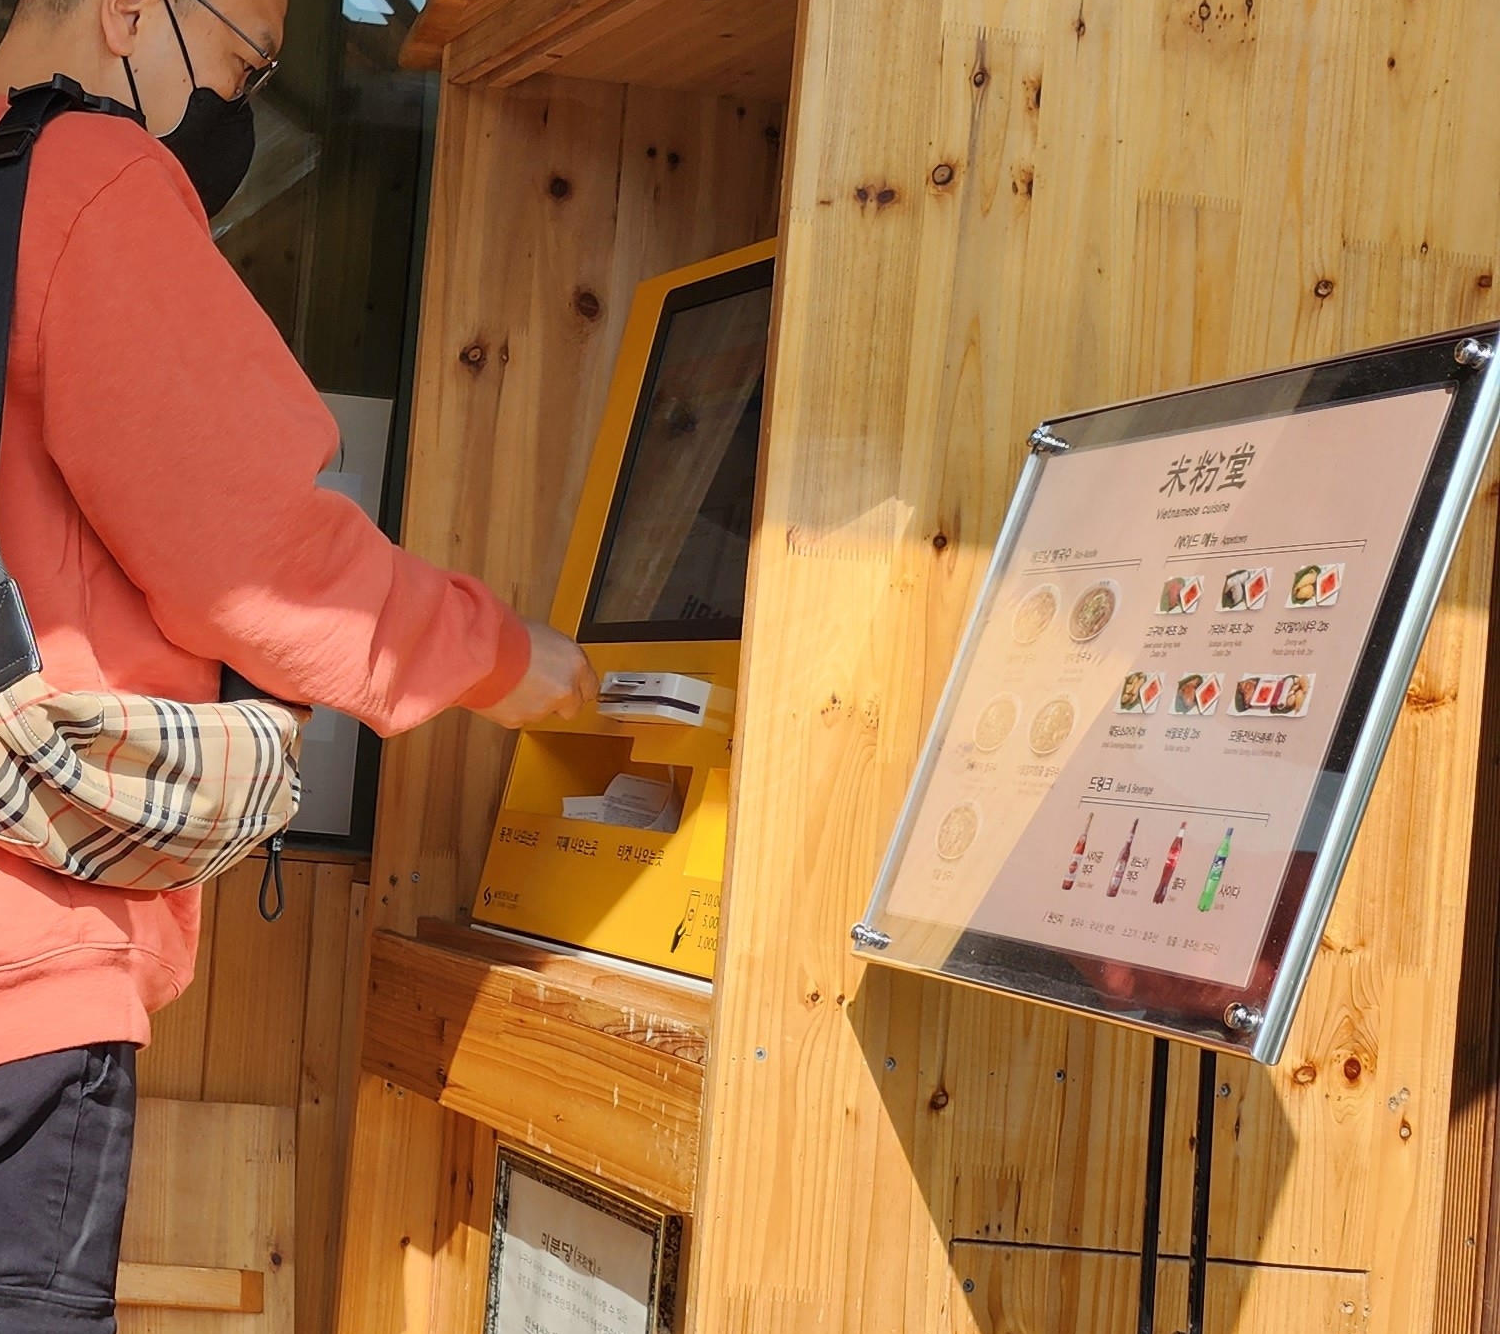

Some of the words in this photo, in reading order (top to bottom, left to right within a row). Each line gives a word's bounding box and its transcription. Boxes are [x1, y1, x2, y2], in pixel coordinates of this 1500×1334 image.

[1159, 442, 1256, 498] 米粉堂
[1156, 507, 1200, 520] Vietnamese
[1202, 501, 1230, 515] cuisine
[1174, 533, 1201, 549] 사이드
[1088, 776, 1113, 792] 드링크
